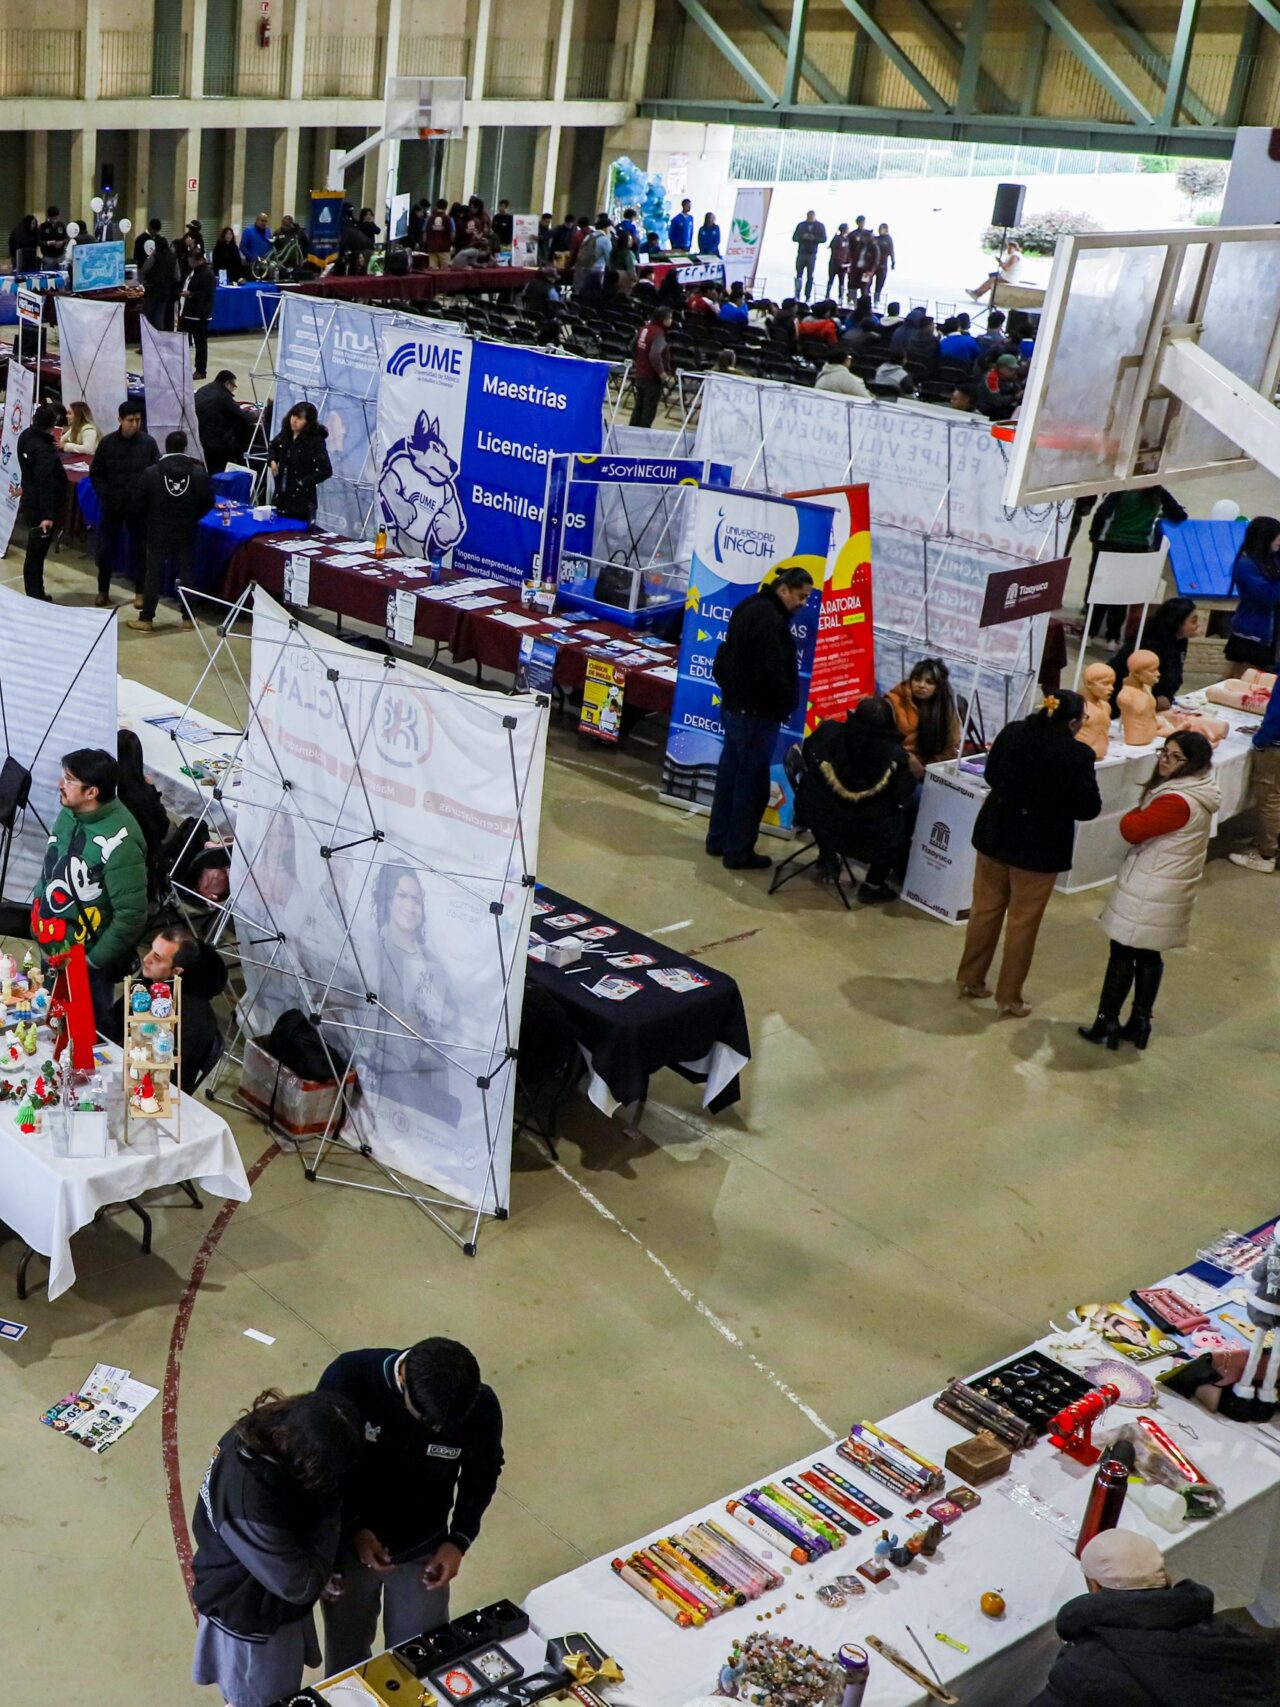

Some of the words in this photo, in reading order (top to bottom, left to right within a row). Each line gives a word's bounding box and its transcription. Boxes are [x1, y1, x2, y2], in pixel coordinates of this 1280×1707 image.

[417, 343, 463, 375] UME
[482, 374, 567, 410] Maestrías
[420, 493, 437, 511] UME
[725, 525, 776, 542] UNIVERSIDAD
[723, 535, 776, 558] INECUH
[454, 561, 466, 571] con
[466, 563, 491, 577] libertad
[491, 572, 523, 588] humanist
[481, 557, 524, 576] emprendedor
[1019, 582, 1049, 596] Tizayuca
[819, 596, 861, 615] ARATORIA
[817, 614, 841, 630] ERAL
[683, 713, 726, 735] DERECH
[921, 844, 953, 866] Tizayuca
